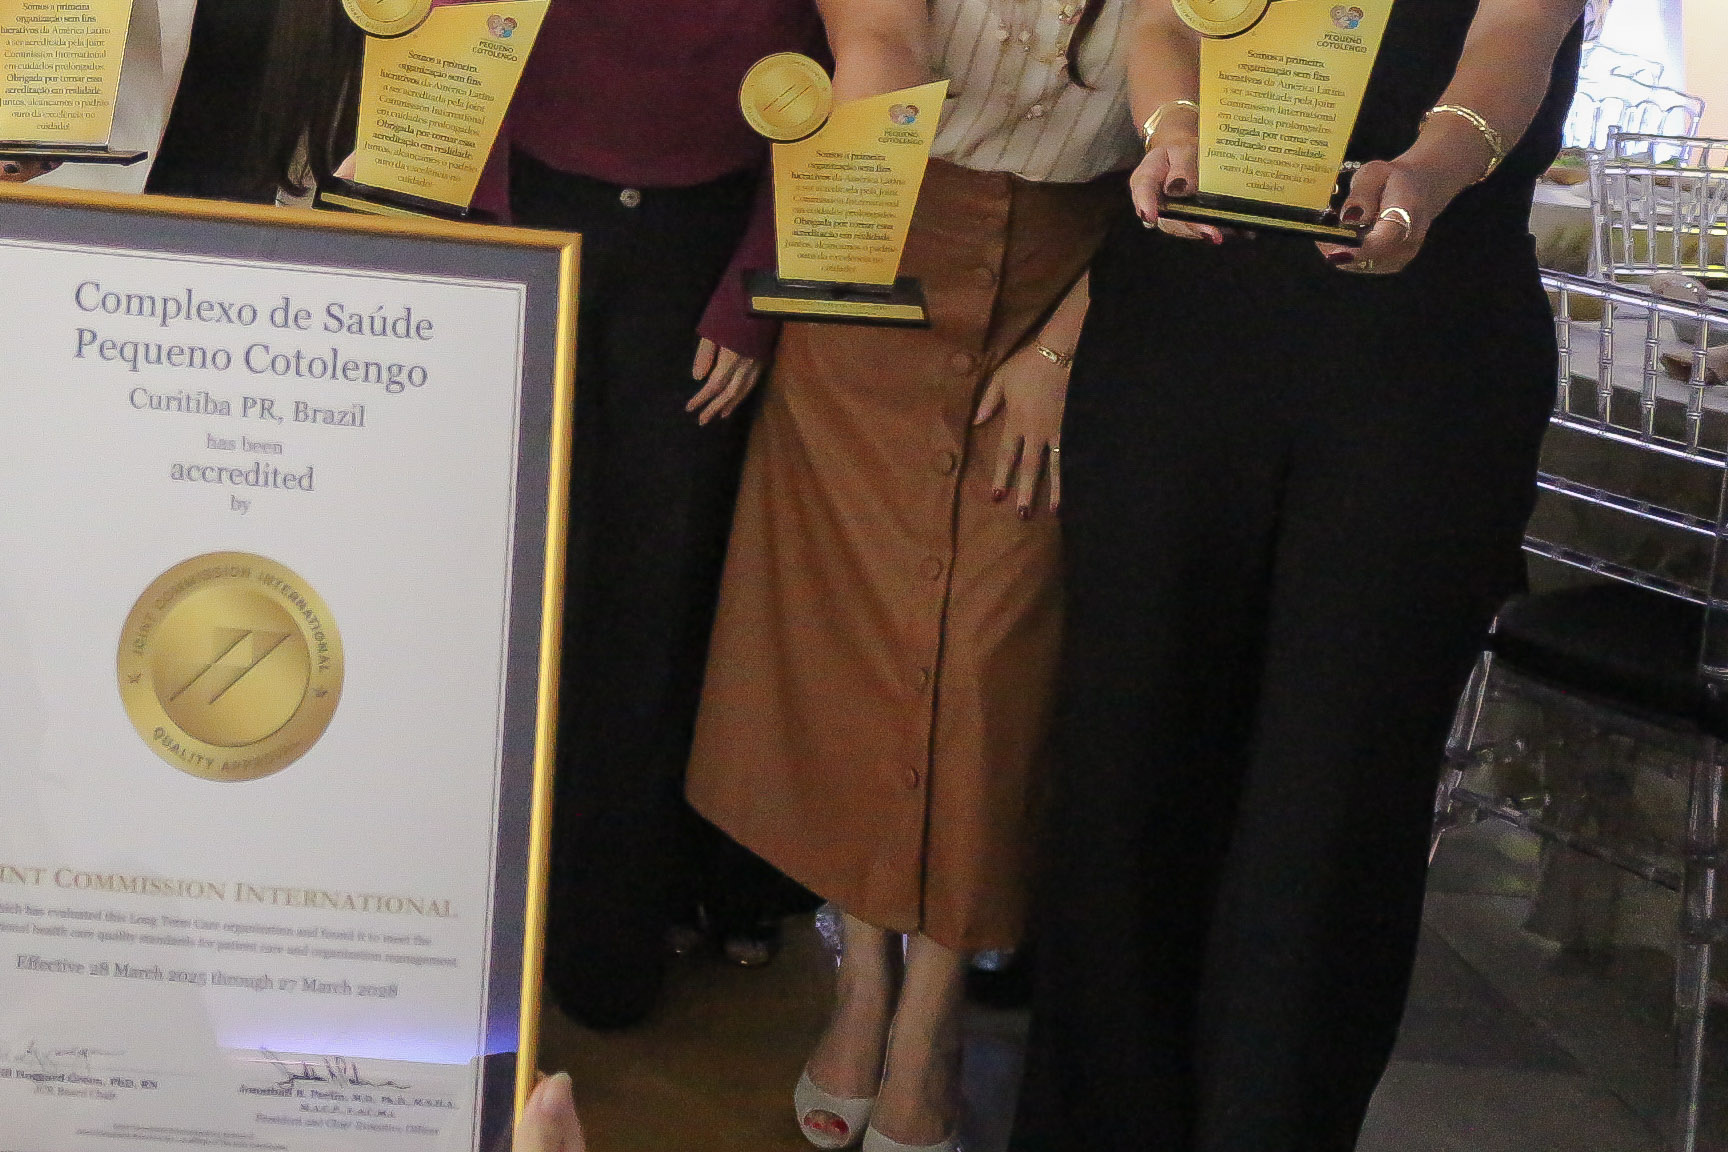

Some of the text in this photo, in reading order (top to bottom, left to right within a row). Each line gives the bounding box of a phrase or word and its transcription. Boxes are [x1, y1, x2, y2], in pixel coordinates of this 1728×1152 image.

[1316, 41, 1367, 52] COTOLENGO
[1323, 34, 1362, 43] PEQUENO
[72, 278, 434, 341] Complexo de Saúde
[72, 326, 430, 394] Pequeno Cotolengo
[127, 384, 367, 429] Curitiba PR, Brazil
[205, 432, 283, 455] has been
[169, 454, 315, 493] accredited
[230, 493, 252, 515] by
[256, 571, 333, 673] INTERNATIONAL
[150, 725, 216, 770] QUALITY
[53, 866, 225, 900] COMMISSION
[235, 881, 459, 919] INTERNATIONAL
